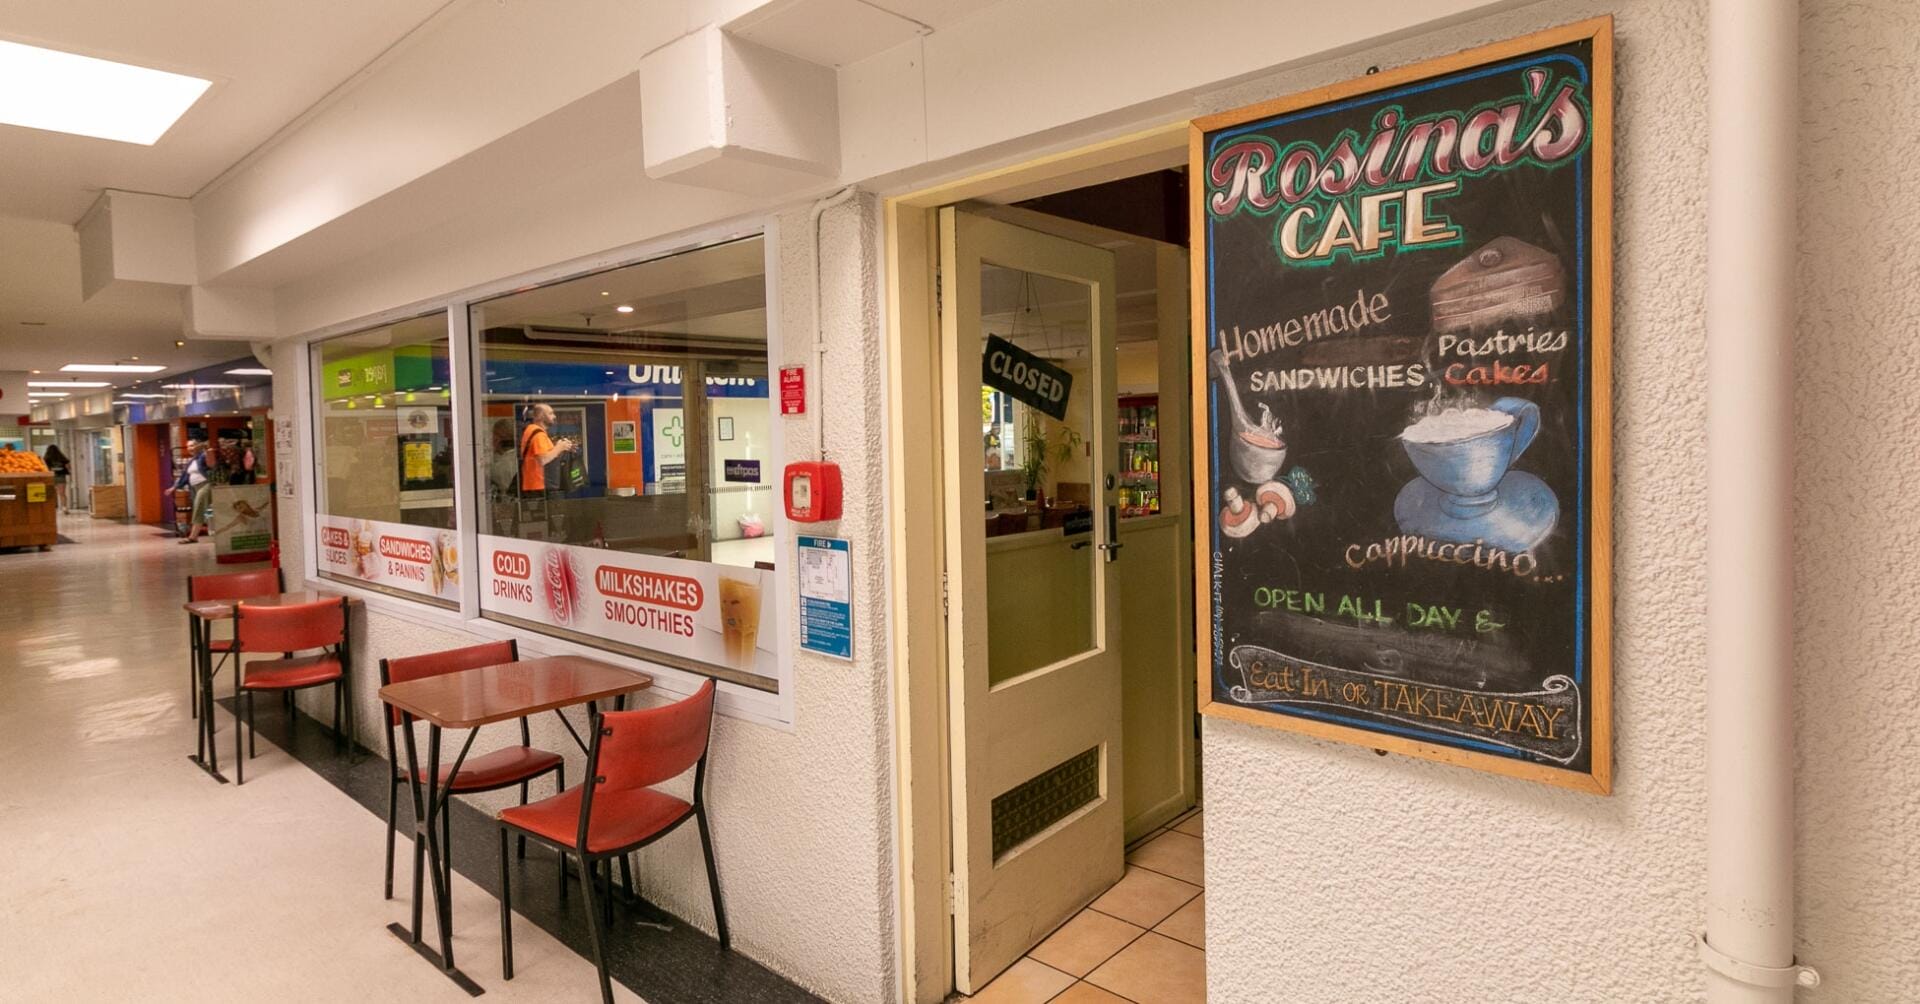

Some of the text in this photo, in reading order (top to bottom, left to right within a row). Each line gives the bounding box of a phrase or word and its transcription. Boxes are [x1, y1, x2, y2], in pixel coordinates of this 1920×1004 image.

[1209, 68, 1587, 217] Rosina's
[1278, 179, 1460, 261] CAFE
[1219, 289, 1392, 366] Homemade
[1438, 326, 1568, 357] Pastries
[990, 350, 1064, 403] CLOSED
[322, 527, 342, 546] CAKES
[380, 538, 432, 561] SANDWICHES
[388, 560, 425, 581] & PANINIS
[496, 553, 527, 576] COLD
[493, 578, 533, 603] DRINKS
[599, 569, 699, 606] MILKSHAKES
[604, 600, 694, 637] SMOOTHIES
[1254, 586, 1505, 633] OPEN ALL DAY &
[1249, 660, 1295, 693] Eat
[1302, 667, 1330, 698] In
[1373, 680, 1564, 740] TAKEAWAY
